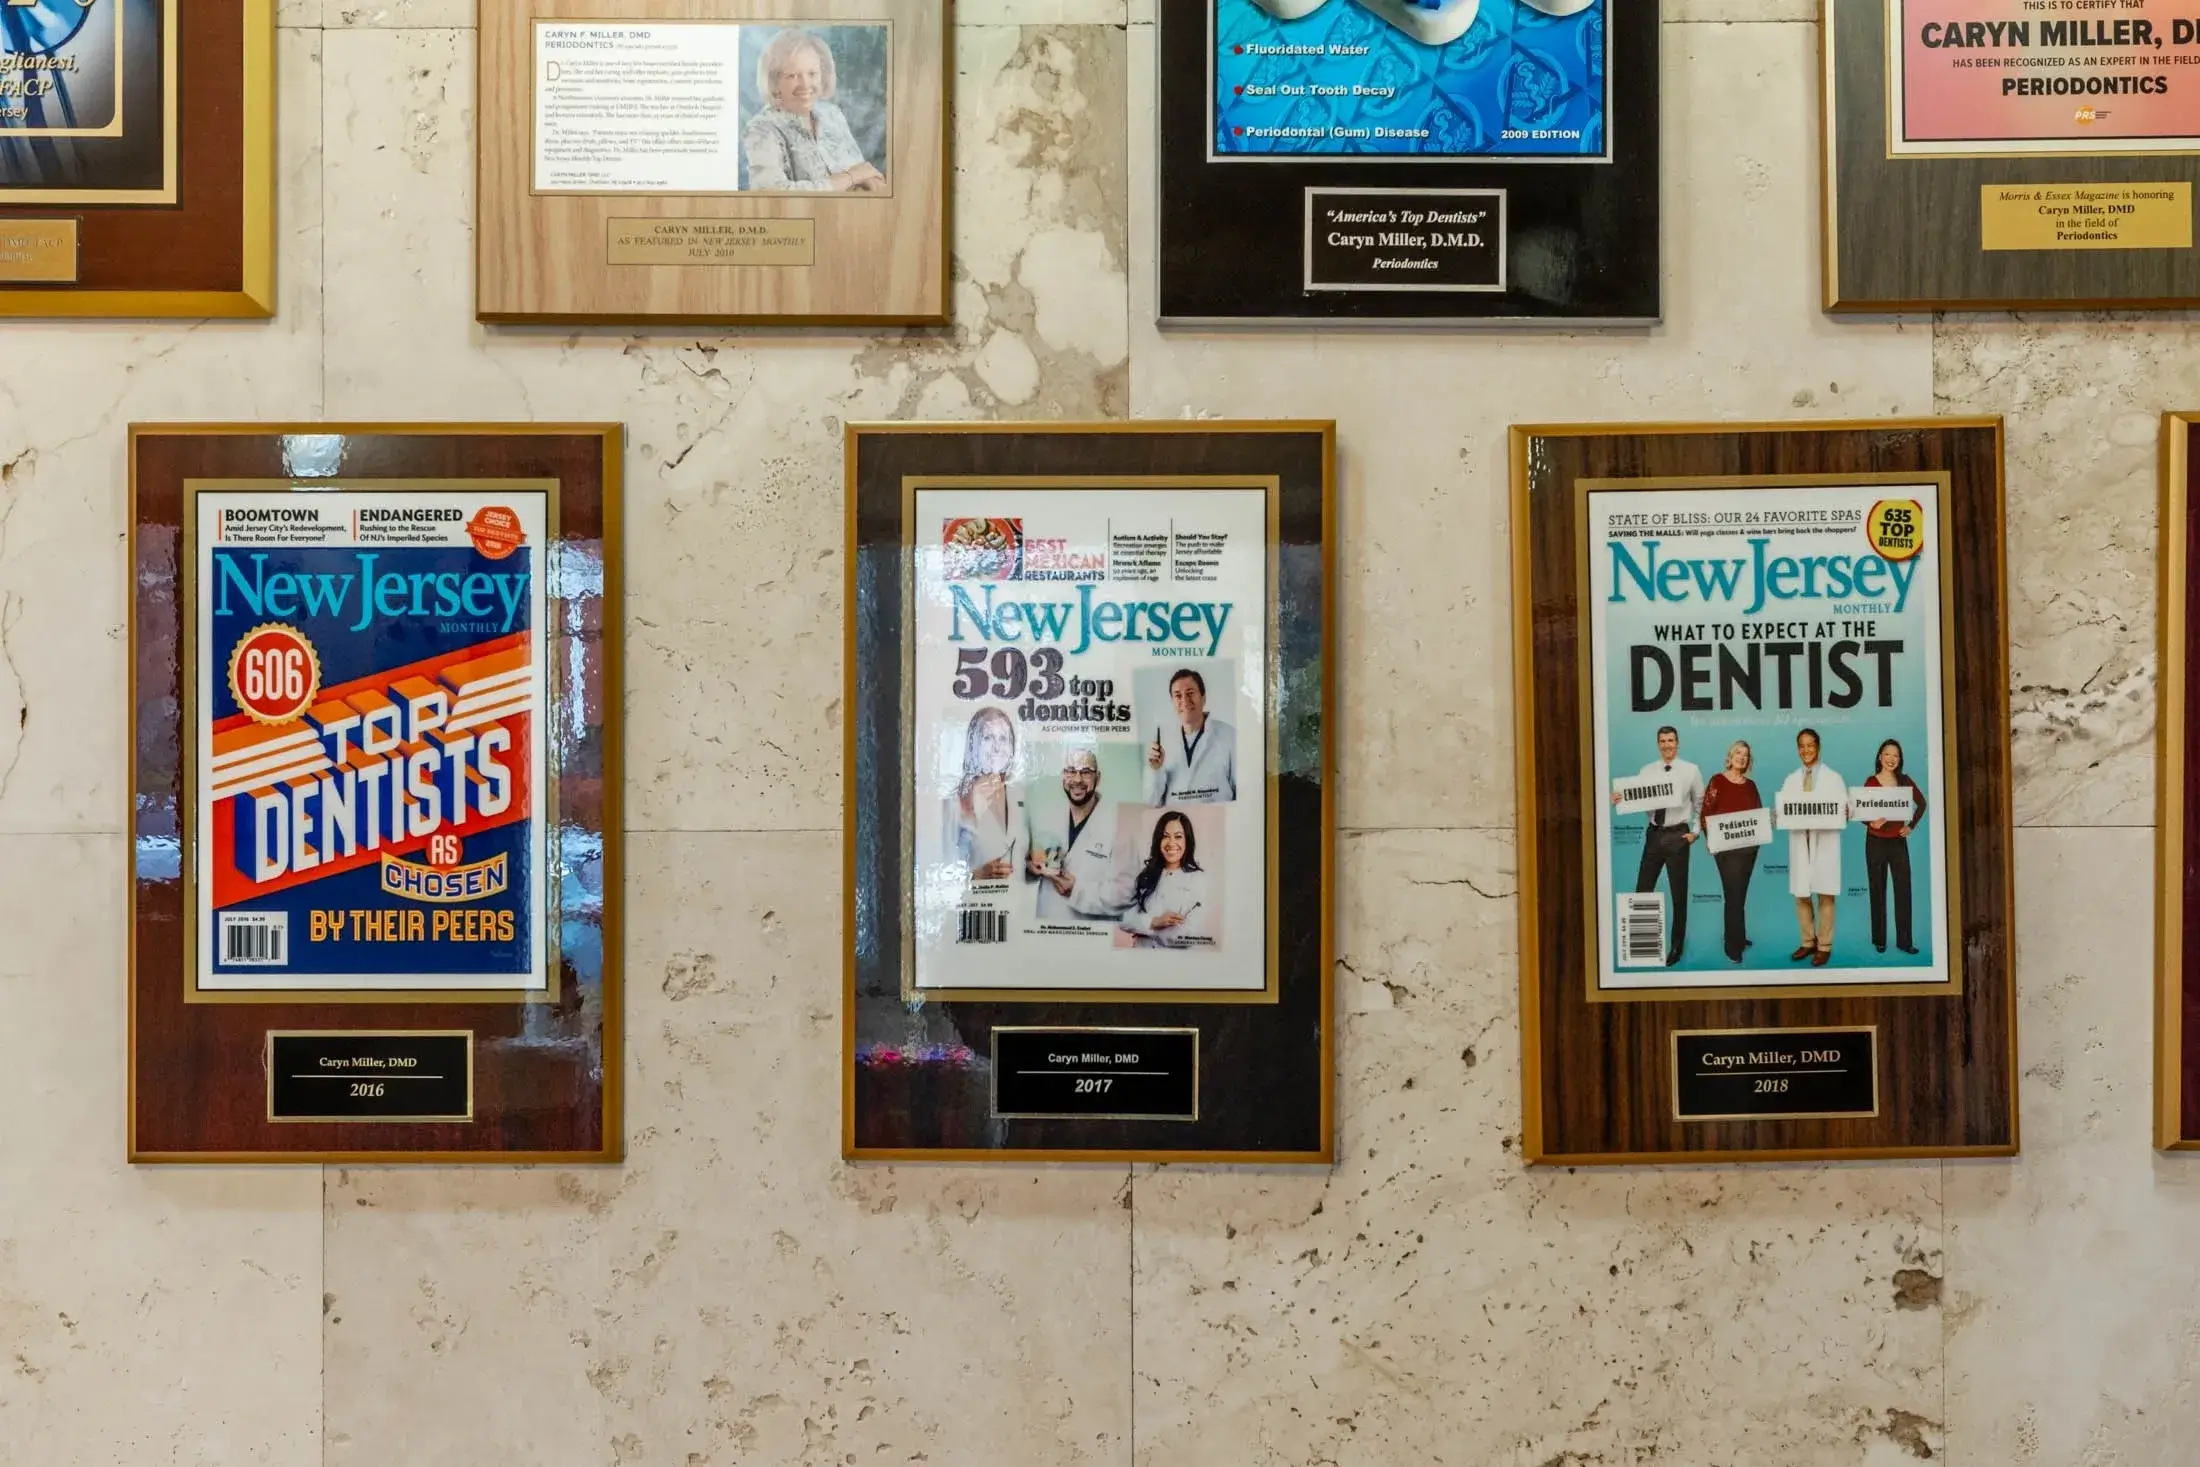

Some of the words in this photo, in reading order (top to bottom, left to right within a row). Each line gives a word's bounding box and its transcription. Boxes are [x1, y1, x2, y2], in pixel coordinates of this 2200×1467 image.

[2023, 0, 2045, 10] THIS
[2048, 0, 2058, 10] IS
[2060, 0, 2074, 10] TO
[2076, 0, 2117, 10] CERTIFY
[2119, 0, 2145, 9] THAT
[545, 31, 577, 39] CARYN
[629, 31, 651, 39] DMD
[1921, 20, 2030, 49] CARYN
[2040, 19, 2163, 50] MILLER,
[2172, 19, 2200, 45] D
[545, 41, 614, 49] PERIODONTICS
[1246, 43, 1325, 56] Fluoridated
[1328, 44, 1370, 56] Water
[1952, 58, 1973, 68] HAS
[1975, 58, 2000, 68] BEEN
[2003, 57, 2065, 68] RECOGNIZED
[2068, 57, 2081, 67] AS
[2083, 57, 2097, 66] AN
[2100, 56, 2137, 66] EXPERT
[2139, 56, 2149, 65] IN
[2152, 55, 2171, 65] THE
[2174, 55, 2200, 65] FIELD
[0, 79, 53, 97] FACP
[1246, 84, 1277, 96] Seal
[1280, 84, 1306, 96] Out
[1309, 84, 1348, 96] Tooth
[1352, 85, 1396, 99] Decay
[2001, 75, 2168, 97] PERIODONTICS
[1246, 126, 1325, 138] Periodontal
[1329, 127, 1371, 140] (Gum)
[1374, 127, 1429, 138] Disease
[1501, 130, 1529, 140] 2009
[1532, 130, 1580, 140] EDITION
[1999, 192, 2030, 201] Morris
[2033, 191, 2042, 201] &
[2045, 191, 2071, 201] Essex
[2075, 190, 2119, 202] Magazine
[2122, 190, 2130, 200] is
[2132, 189, 2174, 201] honoring
[2038, 205, 2070, 216] Caryn
[2072, 204, 2105, 215] Miller,
[2108, 204, 2135, 214] DMD
[1401, 210, 1424, 226] Top
[2056, 219, 2065, 228] in
[2067, 218, 2082, 228] the
[2084, 218, 2106, 228] field
[2108, 217, 2119, 227] of
[654, 226, 689, 234] CARYN
[2057, 231, 2118, 241] Periodontics
[617, 237, 630, 245] AS
[634, 237, 683, 245] FEATURED
[688, 237, 698, 245] IN
[703, 238, 721, 246] NEW
[724, 238, 757, 247] JERSEY
[762, 238, 805, 247] MONTHLY
[1328, 233, 1374, 249] Caryn
[1378, 233, 1427, 249] Miller,
[1431, 233, 1484, 247] D.M.D.
[688, 249, 711, 257] JULY
[1372, 258, 1439, 269] Periodontics
[225, 509, 319, 521] BOOMTOWN
[359, 509, 463, 521] ENDANGERED
[1608, 513, 1649, 527] STATE
[1651, 513, 1670, 526] OF
[1673, 512, 1711, 525] BLISS:
[1714, 511, 1743, 524] OUR
[1745, 511, 1760, 523] 24
[1763, 510, 1828, 523] FAVORITE
[1831, 509, 1862, 522] SPAS
[1883, 508, 1912, 523] 635
[225, 524, 244, 532] Amid
[245, 524, 268, 534] Jersey
[269, 524, 289, 534] City's
[290, 524, 347, 534] Redevelopment,
[359, 524, 387, 534] Rushing
[398, 524, 410, 532] the
[412, 524, 436, 532] Rescue
[1608, 530, 1637, 538] SAVING
[1656, 529, 1684, 537] MALLS:
[1700, 530, 1714, 538] yoga
[1777, 527, 1794, 536] bring
[1812, 526, 1823, 534] the
[1825, 526, 1857, 536] shoppers?
[1879, 522, 1914, 538] TOP
[359, 534, 369, 542] Of
[370, 534, 386, 542] NJ's
[387, 534, 420, 543] Imperiled
[421, 534, 448, 543] Species
[1025, 538, 1067, 552] BEST
[1879, 537, 1914, 549] DENTISTS
[1025, 553, 1105, 569] MEXICAN
[1025, 570, 1105, 581] RESTAURANTS
[1833, 603, 1893, 615] MONTHLY
[440, 622, 499, 633] MONTHLY
[1655, 624, 1705, 641] WHAT
[1711, 623, 1735, 640] TO
[1741, 622, 1808, 640] EXPECT
[1815, 622, 1836, 638] AT
[1843, 620, 1876, 638] THE
[1152, 647, 1205, 657] MONTHLY
[245, 648, 303, 700] 606
[952, 647, 1065, 701] 593
[1069, 674, 1114, 702] top
[1630, 639, 1904, 713] DENTIST
[1018, 697, 1131, 722] dentists
[323, 690, 449, 766] TOP
[1623, 783, 1674, 802] ENDODONTIST
[256, 725, 512, 884] DENTISTS
[1783, 802, 1839, 816] ORTHODONTIST
[1855, 798, 1910, 810] Periodontist
[1719, 817, 1758, 832] Pediatric
[1723, 828, 1756, 841] Dentist
[430, 835, 458, 866] AS
[385, 863, 505, 898] CHOSEN
[310, 910, 346, 942] BY
[350, 910, 424, 942] THEIR
[432, 910, 514, 942] PEERS
[319, 1057, 349, 1069] Caryn
[351, 1057, 386, 1069] Miller,
[388, 1058, 417, 1067] DMD
[1048, 1053, 1078, 1065] Caryn
[1081, 1053, 1112, 1065] Miller,
[1115, 1054, 1139, 1063] DMD
[1702, 1052, 1745, 1069] Caryn
[1749, 1051, 1797, 1066] Miller,
[1801, 1050, 1841, 1063] DMD
[350, 1083, 384, 1097] 2016
[1075, 1079, 1113, 1093] 2017
[1754, 1079, 1789, 1093] 2018
